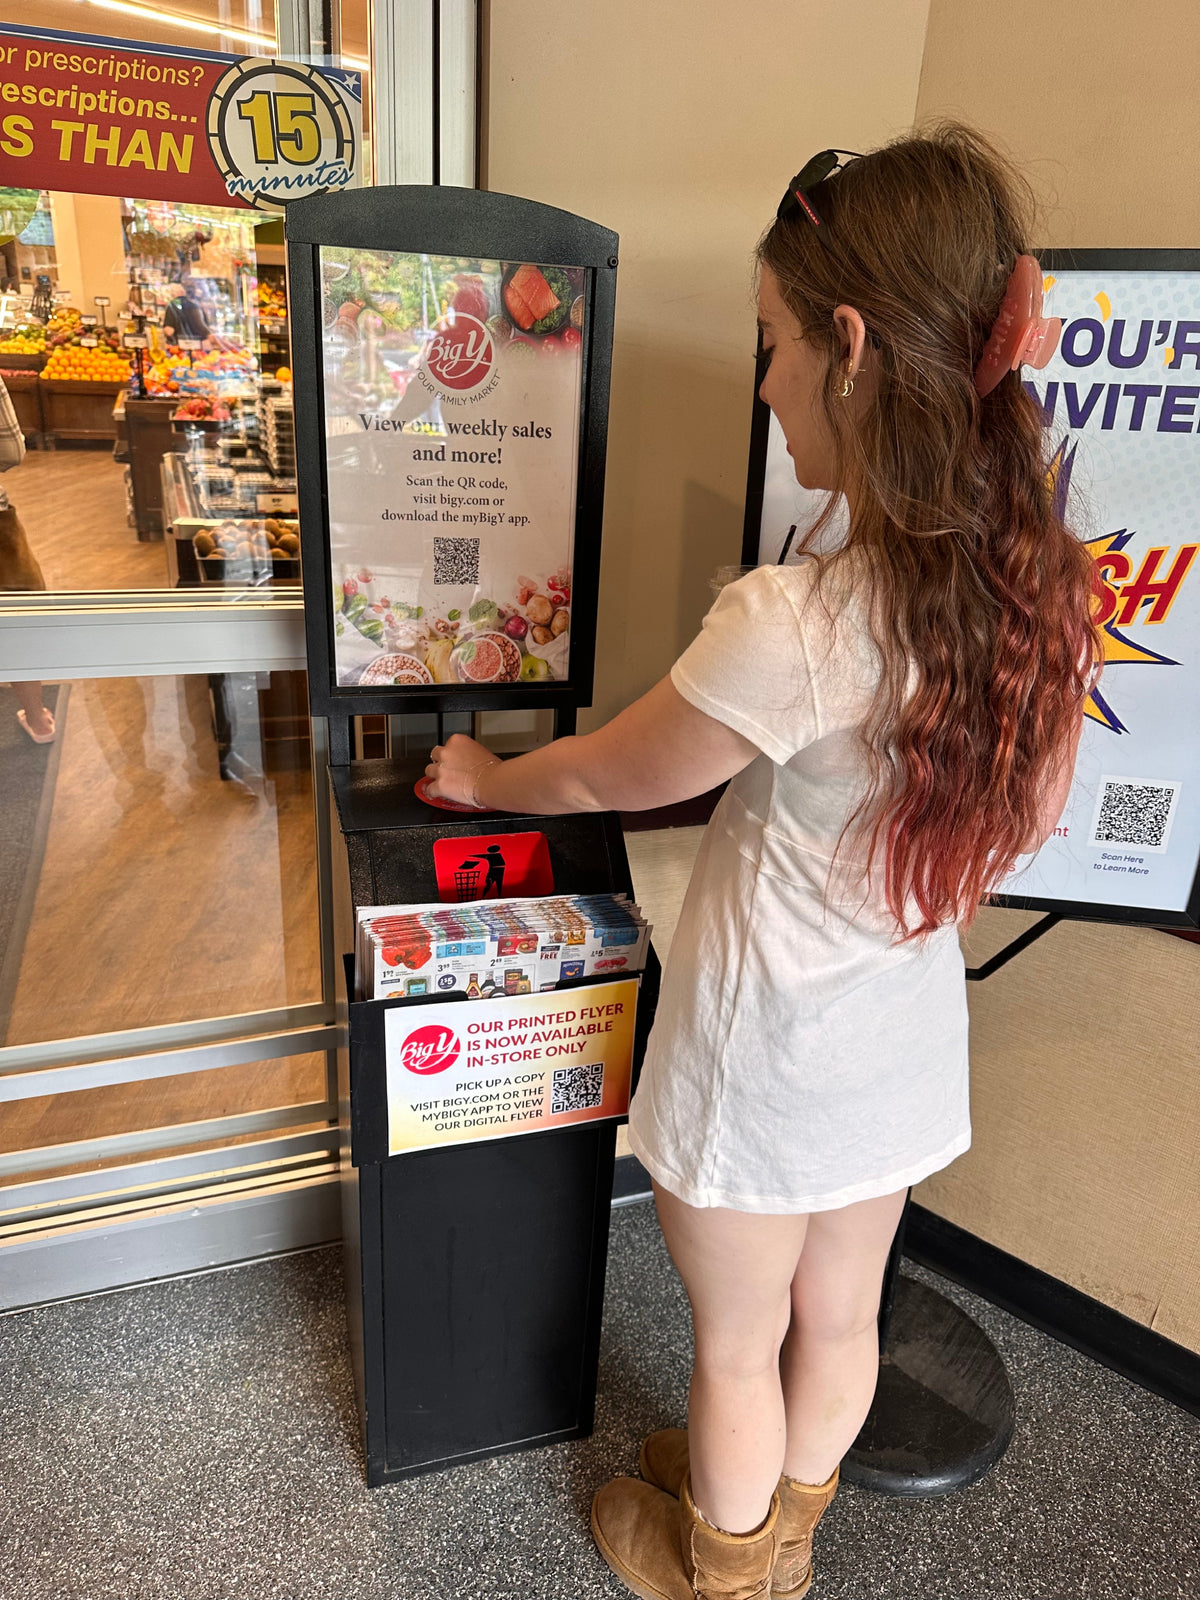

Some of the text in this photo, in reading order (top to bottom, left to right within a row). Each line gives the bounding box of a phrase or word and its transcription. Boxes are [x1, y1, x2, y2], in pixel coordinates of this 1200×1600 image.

[25, 49, 205, 88] prescriptions?
[0, 82, 198, 124] escriptions...
[236, 90, 322, 166] 15
[0, 114, 195, 174] S THAN
[228, 161, 354, 194] minutes
[424, 336, 465, 372] Big
[1060, 318, 1200, 370] OU'R
[416, 367, 502, 406] YOUR FAMILY MARKET
[1022, 381, 1200, 434] NVITE
[359, 413, 552, 441] View our weekly sales
[413, 445, 502, 464] and more!
[406, 475, 508, 491] Scan the QR code,
[413, 494, 505, 508] visit bigy.com or
[381, 509, 531, 527] download the myBigY app.
[1101, 853, 1144, 864] Scan Here
[1103, 864, 1127, 872] Learn
[1128, 866, 1149, 875] More
[467, 1003, 624, 1034] OUR PRINTED FLYER
[467, 1021, 613, 1052] IS NOW AVAILABLE
[400, 1042, 433, 1067] Big
[467, 1040, 587, 1068] IN-STORE ONLY
[456, 1072, 545, 1091] PICK UP A COPY
[410, 1086, 544, 1112] VISIT BIGY.COM OR THE
[422, 1098, 543, 1122] MYBIGY APP TO VIEW
[434, 1109, 543, 1131] OUR DIGITAL FLYER
